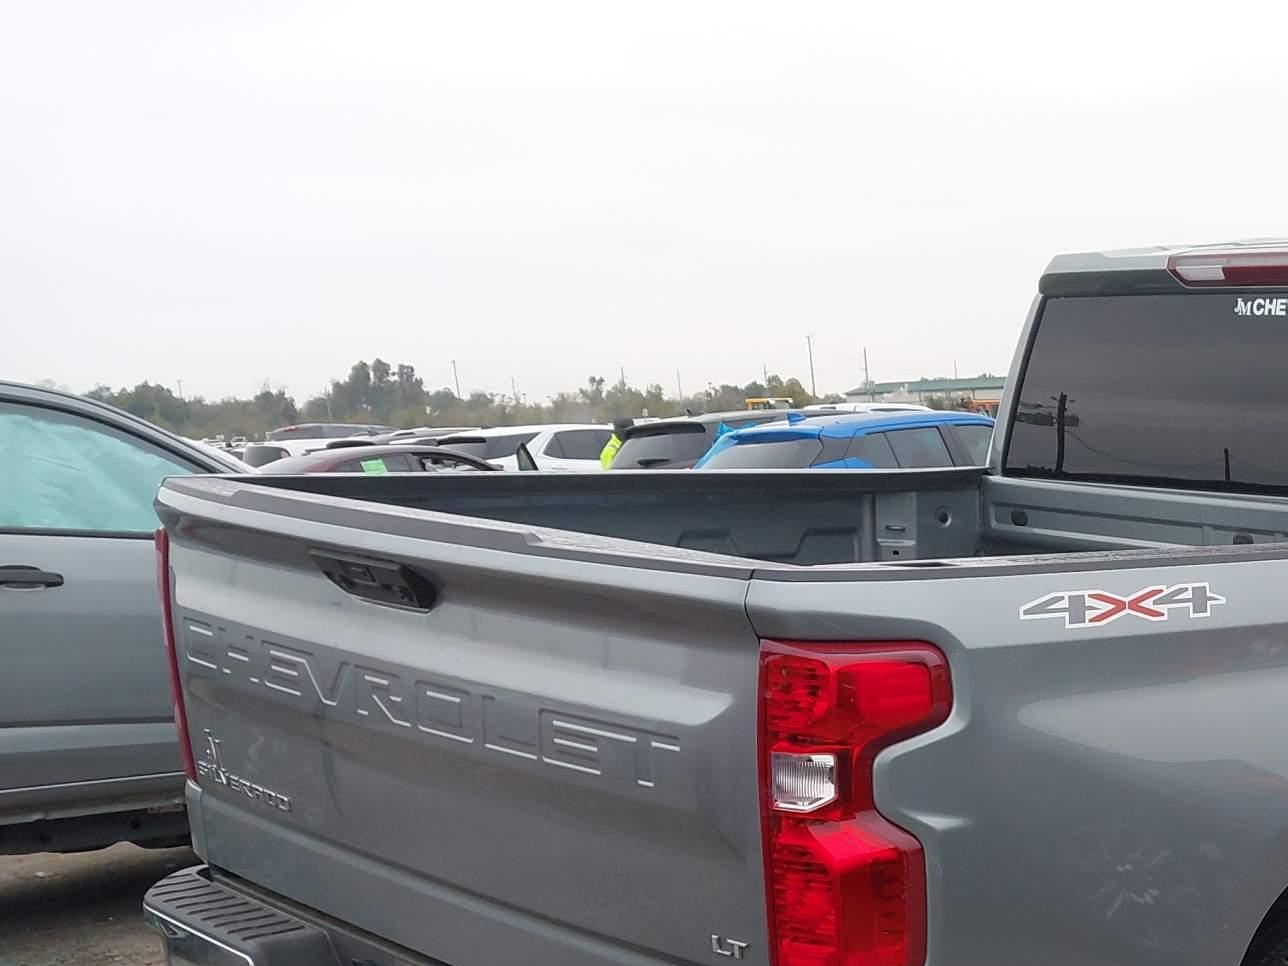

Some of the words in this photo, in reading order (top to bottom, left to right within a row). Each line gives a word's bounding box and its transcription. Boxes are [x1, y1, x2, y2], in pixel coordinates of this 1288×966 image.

[181, 616, 683, 789] CHEVROLET
[197, 760, 292, 811] SILVERADO
[711, 934, 749, 959] LT
